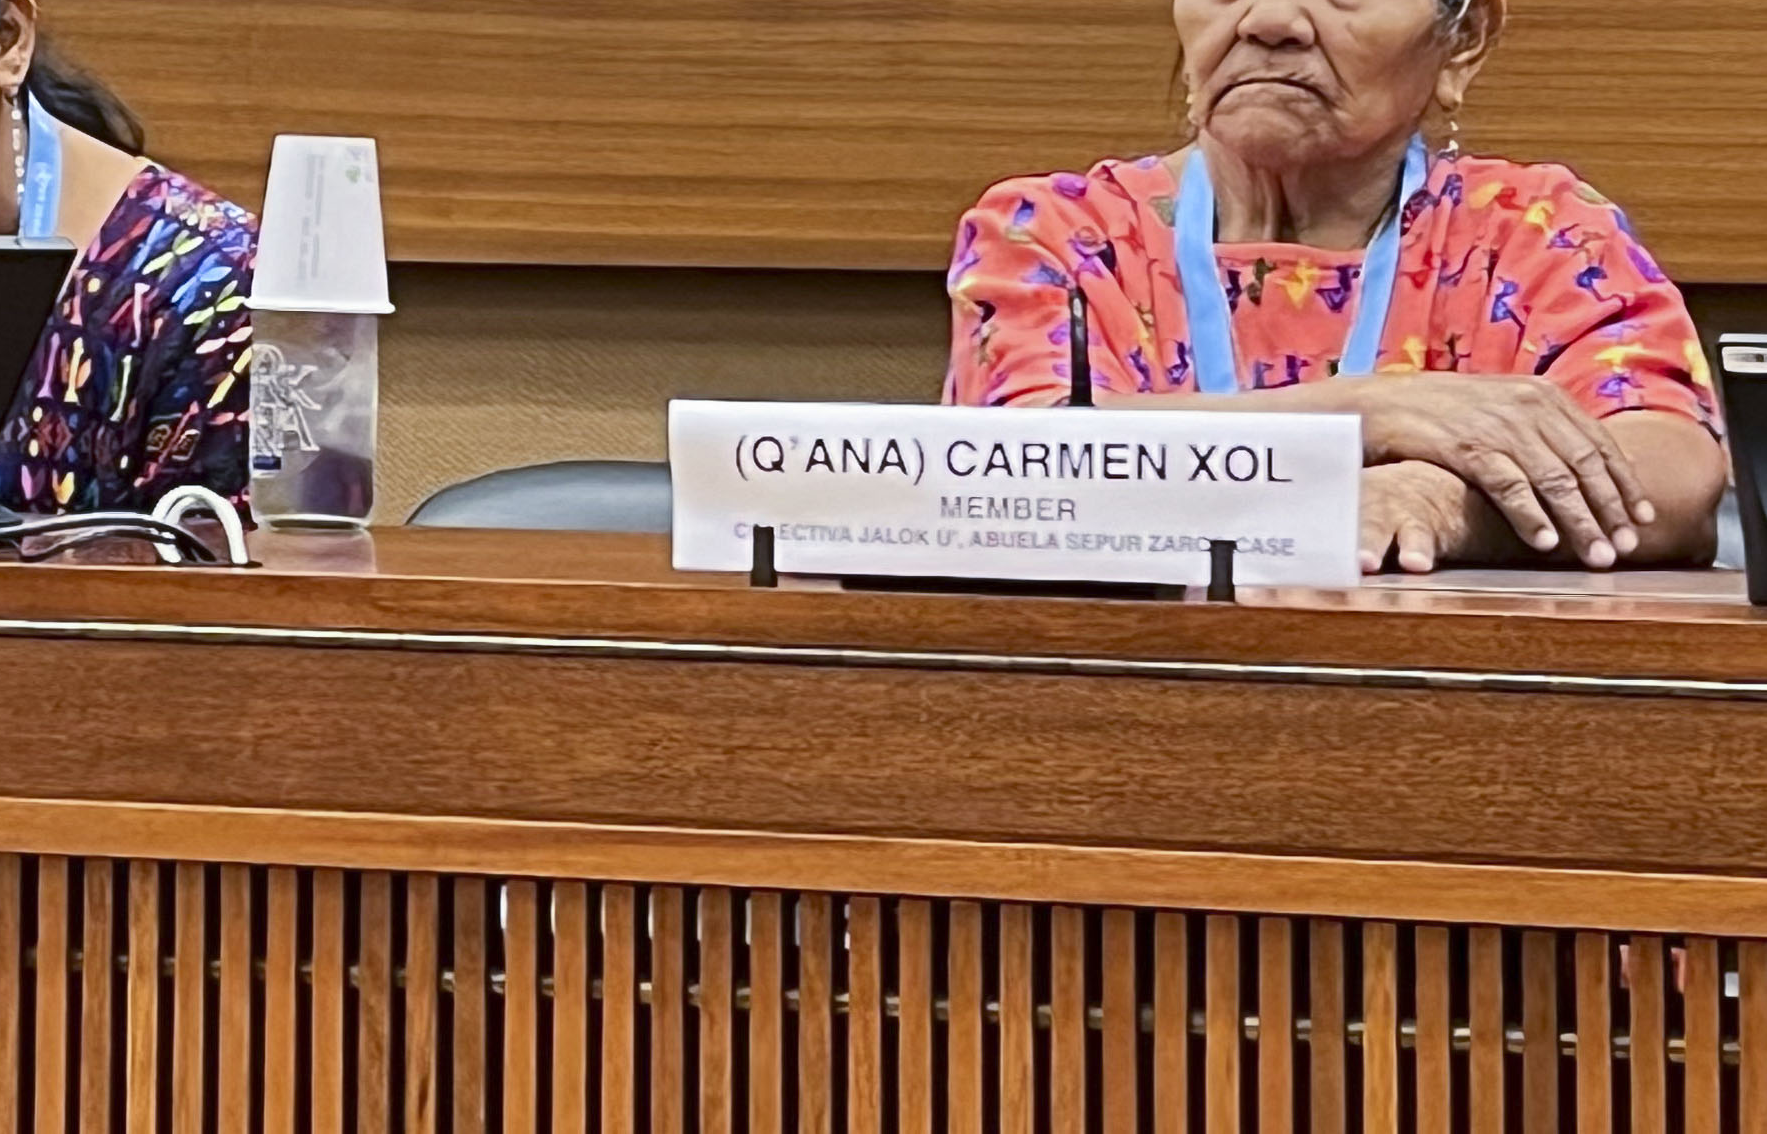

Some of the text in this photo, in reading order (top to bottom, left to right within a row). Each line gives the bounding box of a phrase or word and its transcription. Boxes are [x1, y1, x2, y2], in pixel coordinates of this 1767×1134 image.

[945, 439, 1168, 483] CARMEN
[1187, 443, 1293, 483] XOL
[939, 496, 1077, 522] MEMBER
[733, 522, 853, 543] CECTIVA
[857, 526, 930, 546] JALOK
[969, 530, 1060, 551] ABUELA
[1065, 533, 1143, 553] SEPUR
[1234, 537, 1296, 556] CASE
